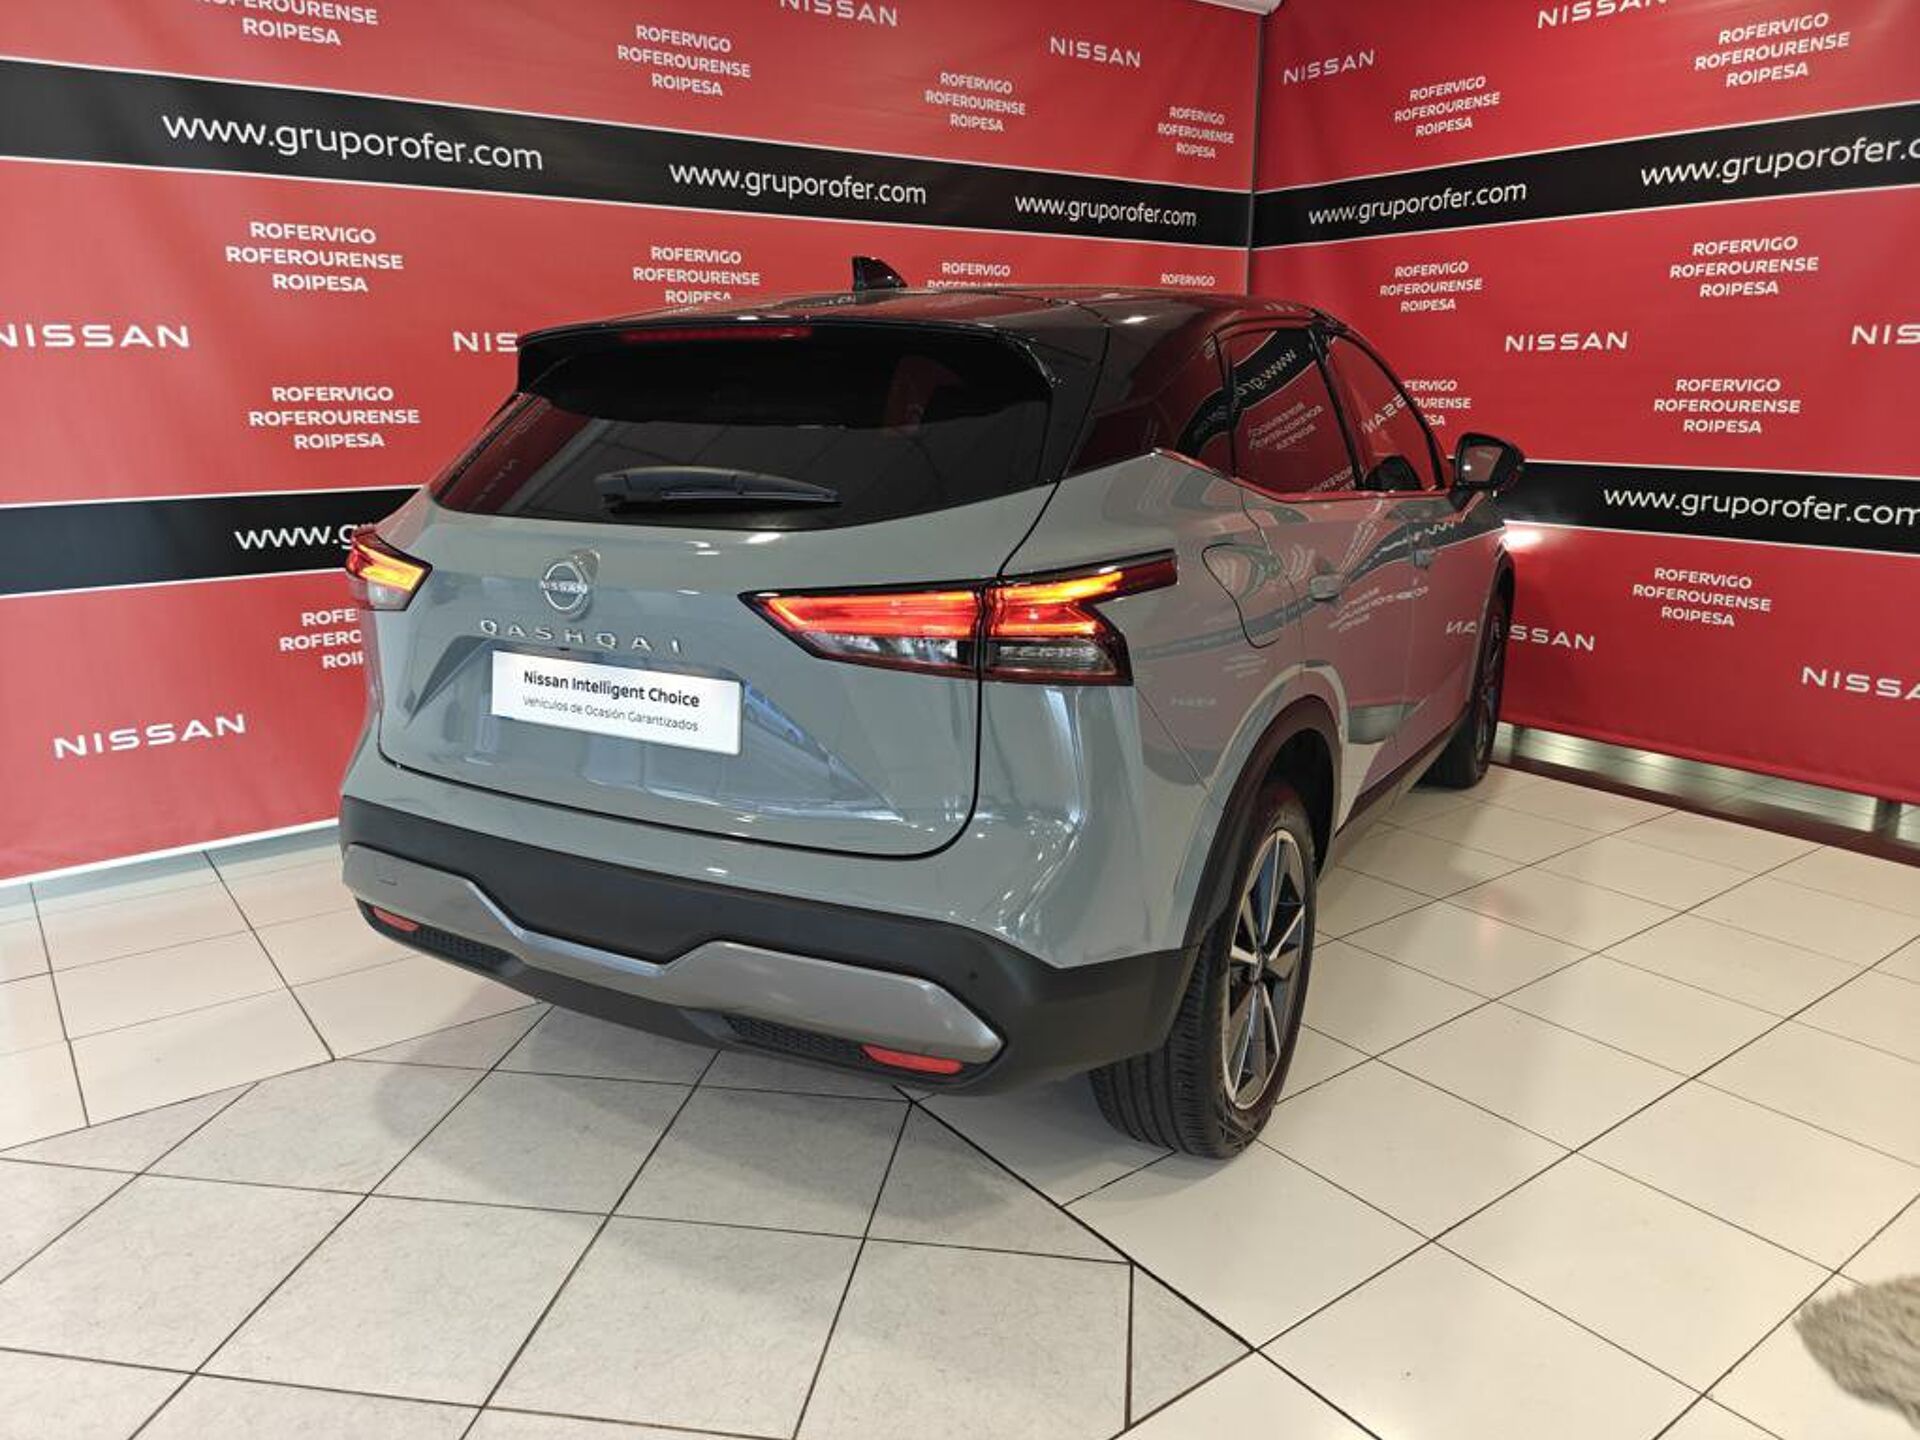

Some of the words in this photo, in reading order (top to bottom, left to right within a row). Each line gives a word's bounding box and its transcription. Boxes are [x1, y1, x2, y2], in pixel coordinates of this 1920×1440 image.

[242, 17, 342, 45] ROIPESA
[635, 24, 732, 53] ROFERVIGO
[1718, 12, 1830, 45] ROFERVIGO
[617, 45, 751, 78] ROFEROURENSE
[1049, 36, 1141, 68] NISSAN
[1694, 31, 1851, 71] ROFEROURENSE
[1283, 49, 1375, 85] NISSAN
[1725, 61, 1809, 88] ROIPESA
[651, 72, 723, 96] ROIPESA
[940, 72, 1013, 95] ROFERVIGO
[1410, 75, 1487, 102] ROFERVIGO
[925, 89, 1026, 115] ROFEROURENSE
[1394, 91, 1501, 123] ROFEROURENSE
[950, 113, 1005, 132] ROIPESA
[1169, 106, 1225, 125] ROFERVIGO
[1415, 116, 1473, 137] ROIPESA
[162, 114, 543, 170] www.gruporofer.com
[1157, 122, 1235, 144] ROFEROURENSE
[1176, 143, 1217, 159] ROIPESA
[669, 164, 926, 204] www.gruporofer.com
[1015, 196, 1197, 227] www.gruporofer.com
[1308, 183, 1527, 225] www.gruporofer.com
[249, 221, 377, 245] ROFERVIGO
[651, 246, 742, 264] ROFERVIGO
[1692, 236, 1799, 256] ROFERVIGO
[225, 246, 405, 270] ROFEROURENSE
[1394, 260, 1469, 278] ROFERVIGO
[1669, 256, 1820, 280] ROFEROURENSE
[632, 266, 761, 286] ROFEROURENSE
[941, 262, 1011, 278] ROFERVIGO
[1160, 273, 1216, 287] ROFERVIGO
[272, 273, 369, 292] ROIPESA
[1379, 277, 1483, 297] ROFEROURENSE
[1699, 281, 1779, 298] ROIPESA
[1400, 298, 1458, 313] ROIPESA
[1504, 330, 1629, 353] NISSAN
[271, 386, 395, 402] ROFERVIGO
[1675, 378, 1782, 394] ROFERVIGO
[248, 409, 421, 427] ROFEROURENSE
[1653, 398, 1802, 415] ROFEROURENSE
[1683, 418, 1763, 434] ROIPESA
[293, 432, 386, 450] ROIPESA
[1603, 488, 1920, 526] www.gruporofer.com
[540, 579, 588, 595] NISSAN
[1654, 567, 1753, 589] ROFERVIGO
[1632, 584, 1772, 612] ROFEROURENSE
[1661, 606, 1735, 627] ROIPESA
[480, 619, 682, 654] QASHQAI
[523, 671, 569, 689] Nissan
[572, 677, 645, 700] Intelligent
[648, 688, 700, 708] Choice
[569, 703, 583, 715] de
[585, 704, 625, 721] Ocasión
[628, 711, 699, 732] Garantizados
[53, 713, 247, 759] NISSAN
